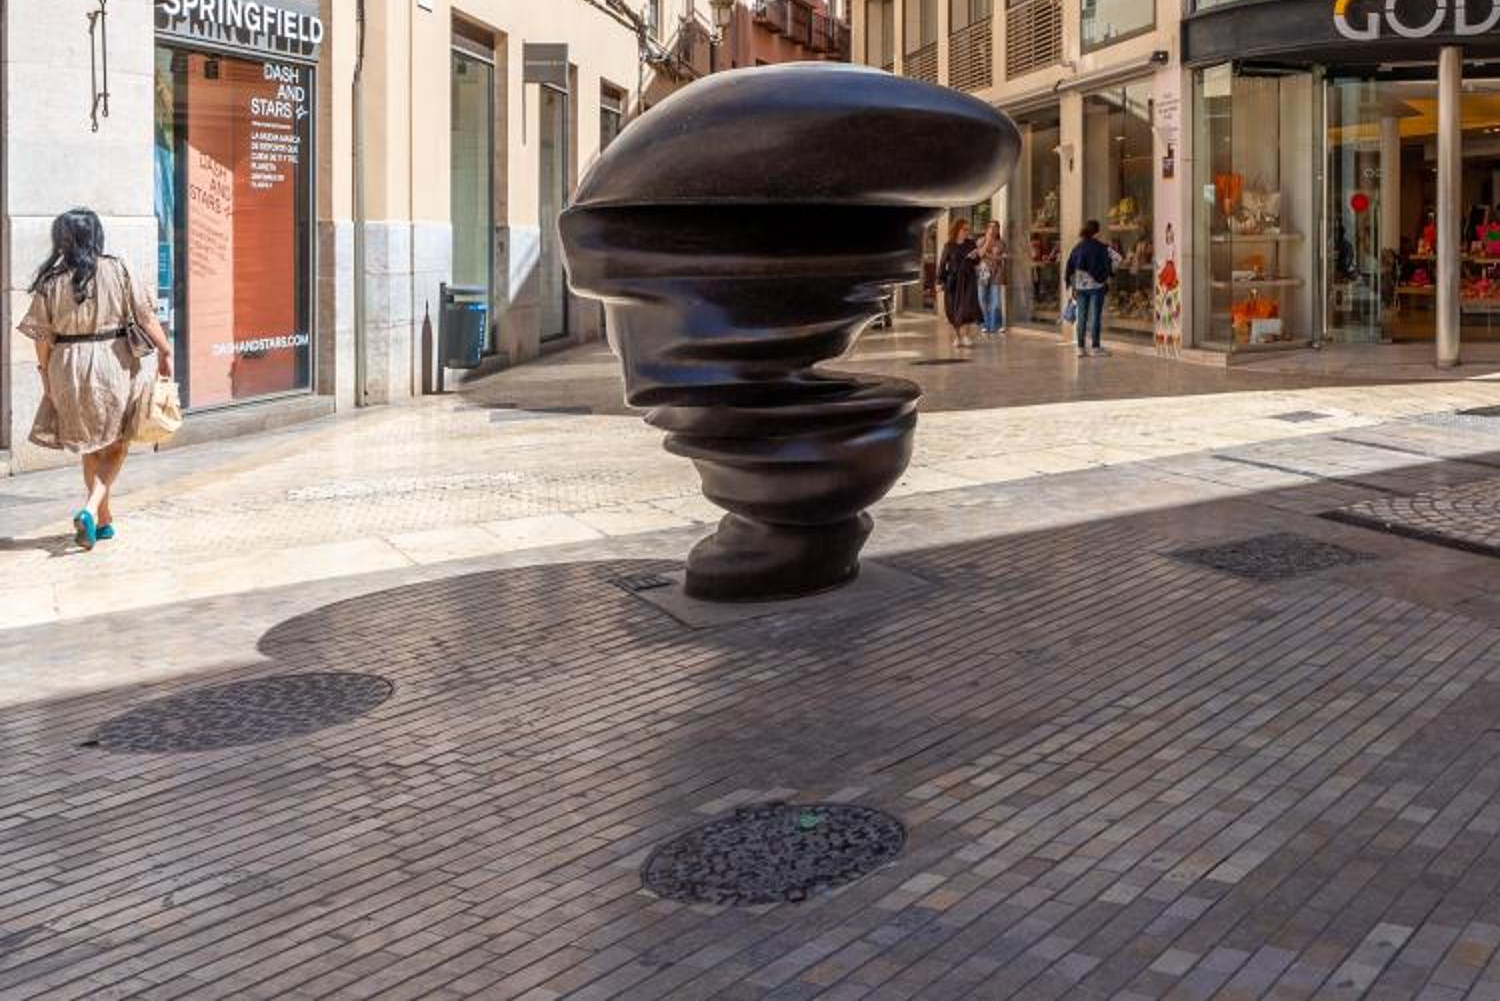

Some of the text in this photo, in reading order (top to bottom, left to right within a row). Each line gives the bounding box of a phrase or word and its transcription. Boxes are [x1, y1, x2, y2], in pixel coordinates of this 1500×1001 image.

[263, 63, 299, 84] DASH
[277, 85, 305, 102] AND
[251, 97, 293, 119] STARS
